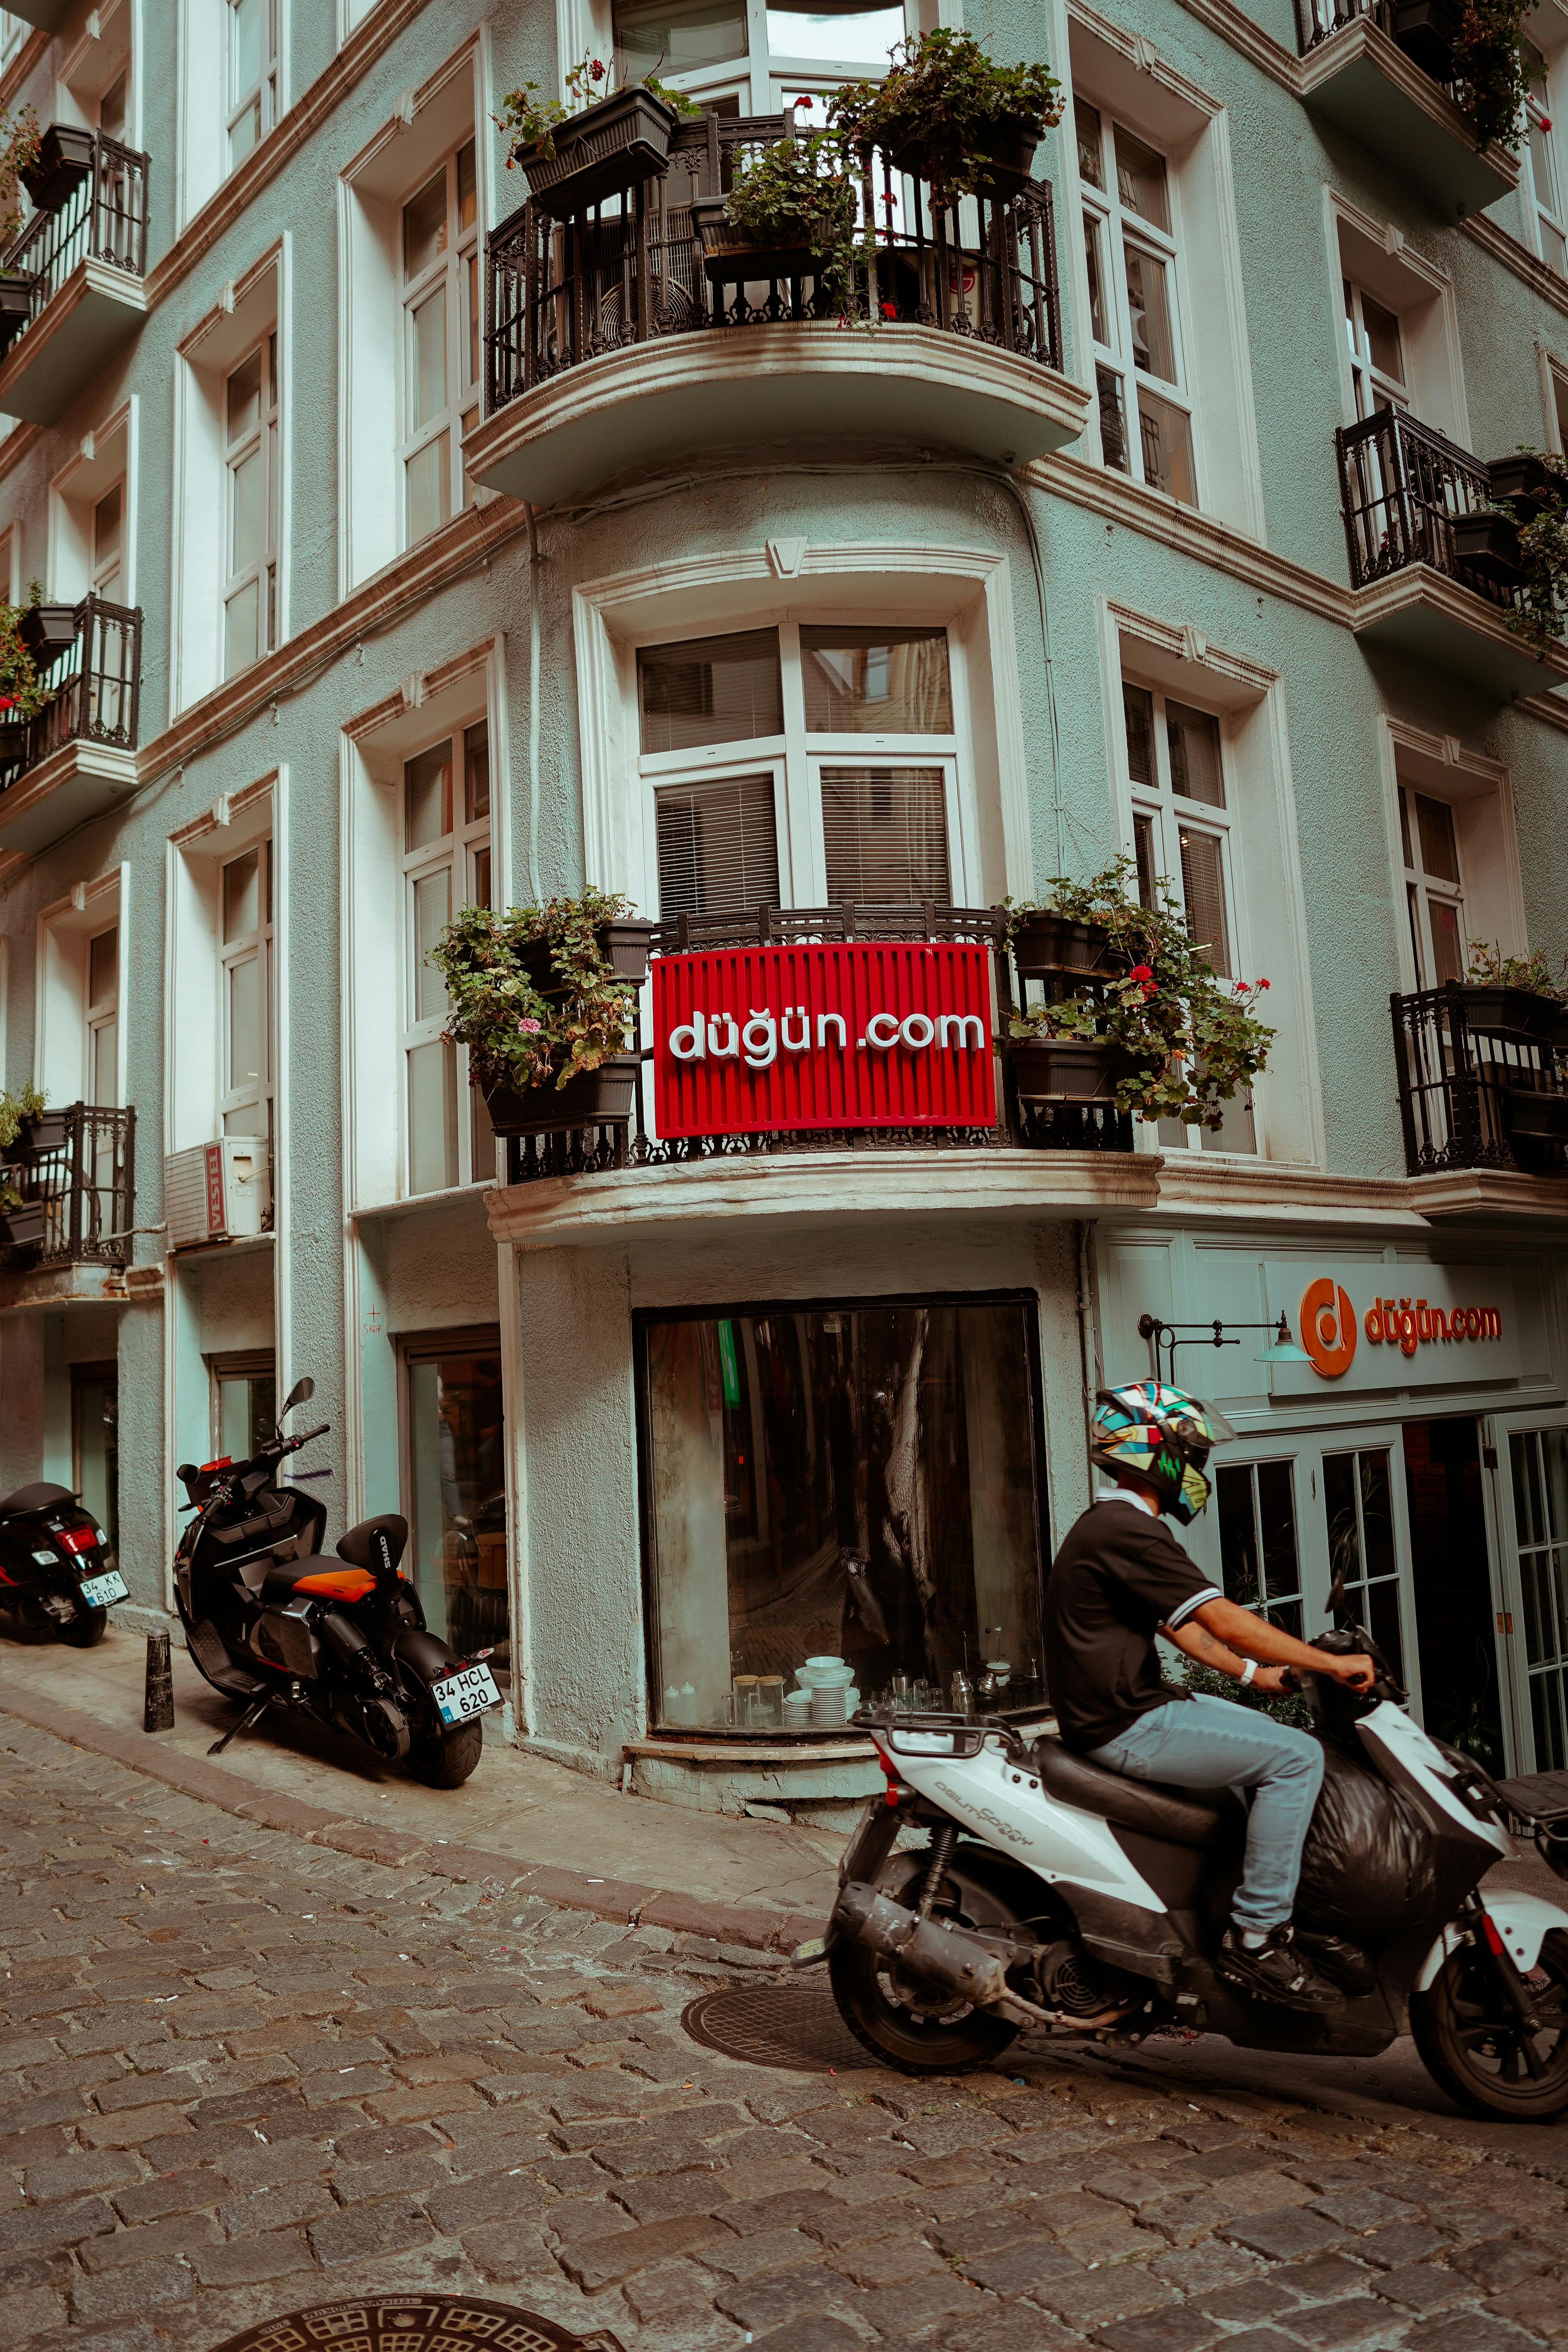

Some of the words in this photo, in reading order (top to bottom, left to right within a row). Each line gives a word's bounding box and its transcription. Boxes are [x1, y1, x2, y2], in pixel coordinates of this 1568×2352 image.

[669, 1006, 984, 1070] düğün.com
[210, 1149, 221, 1228] VESTEL
[1364, 1297, 1502, 1354] düğün.com
[380, 1536, 391, 1569] SHAD
[83, 1582, 98, 1594] 34
[105, 1573, 120, 1586] KK
[96, 1588, 116, 1602] 610
[436, 1681, 455, 1701] 34
[457, 1668, 490, 1691] HCL
[460, 1689, 488, 1712] 620
